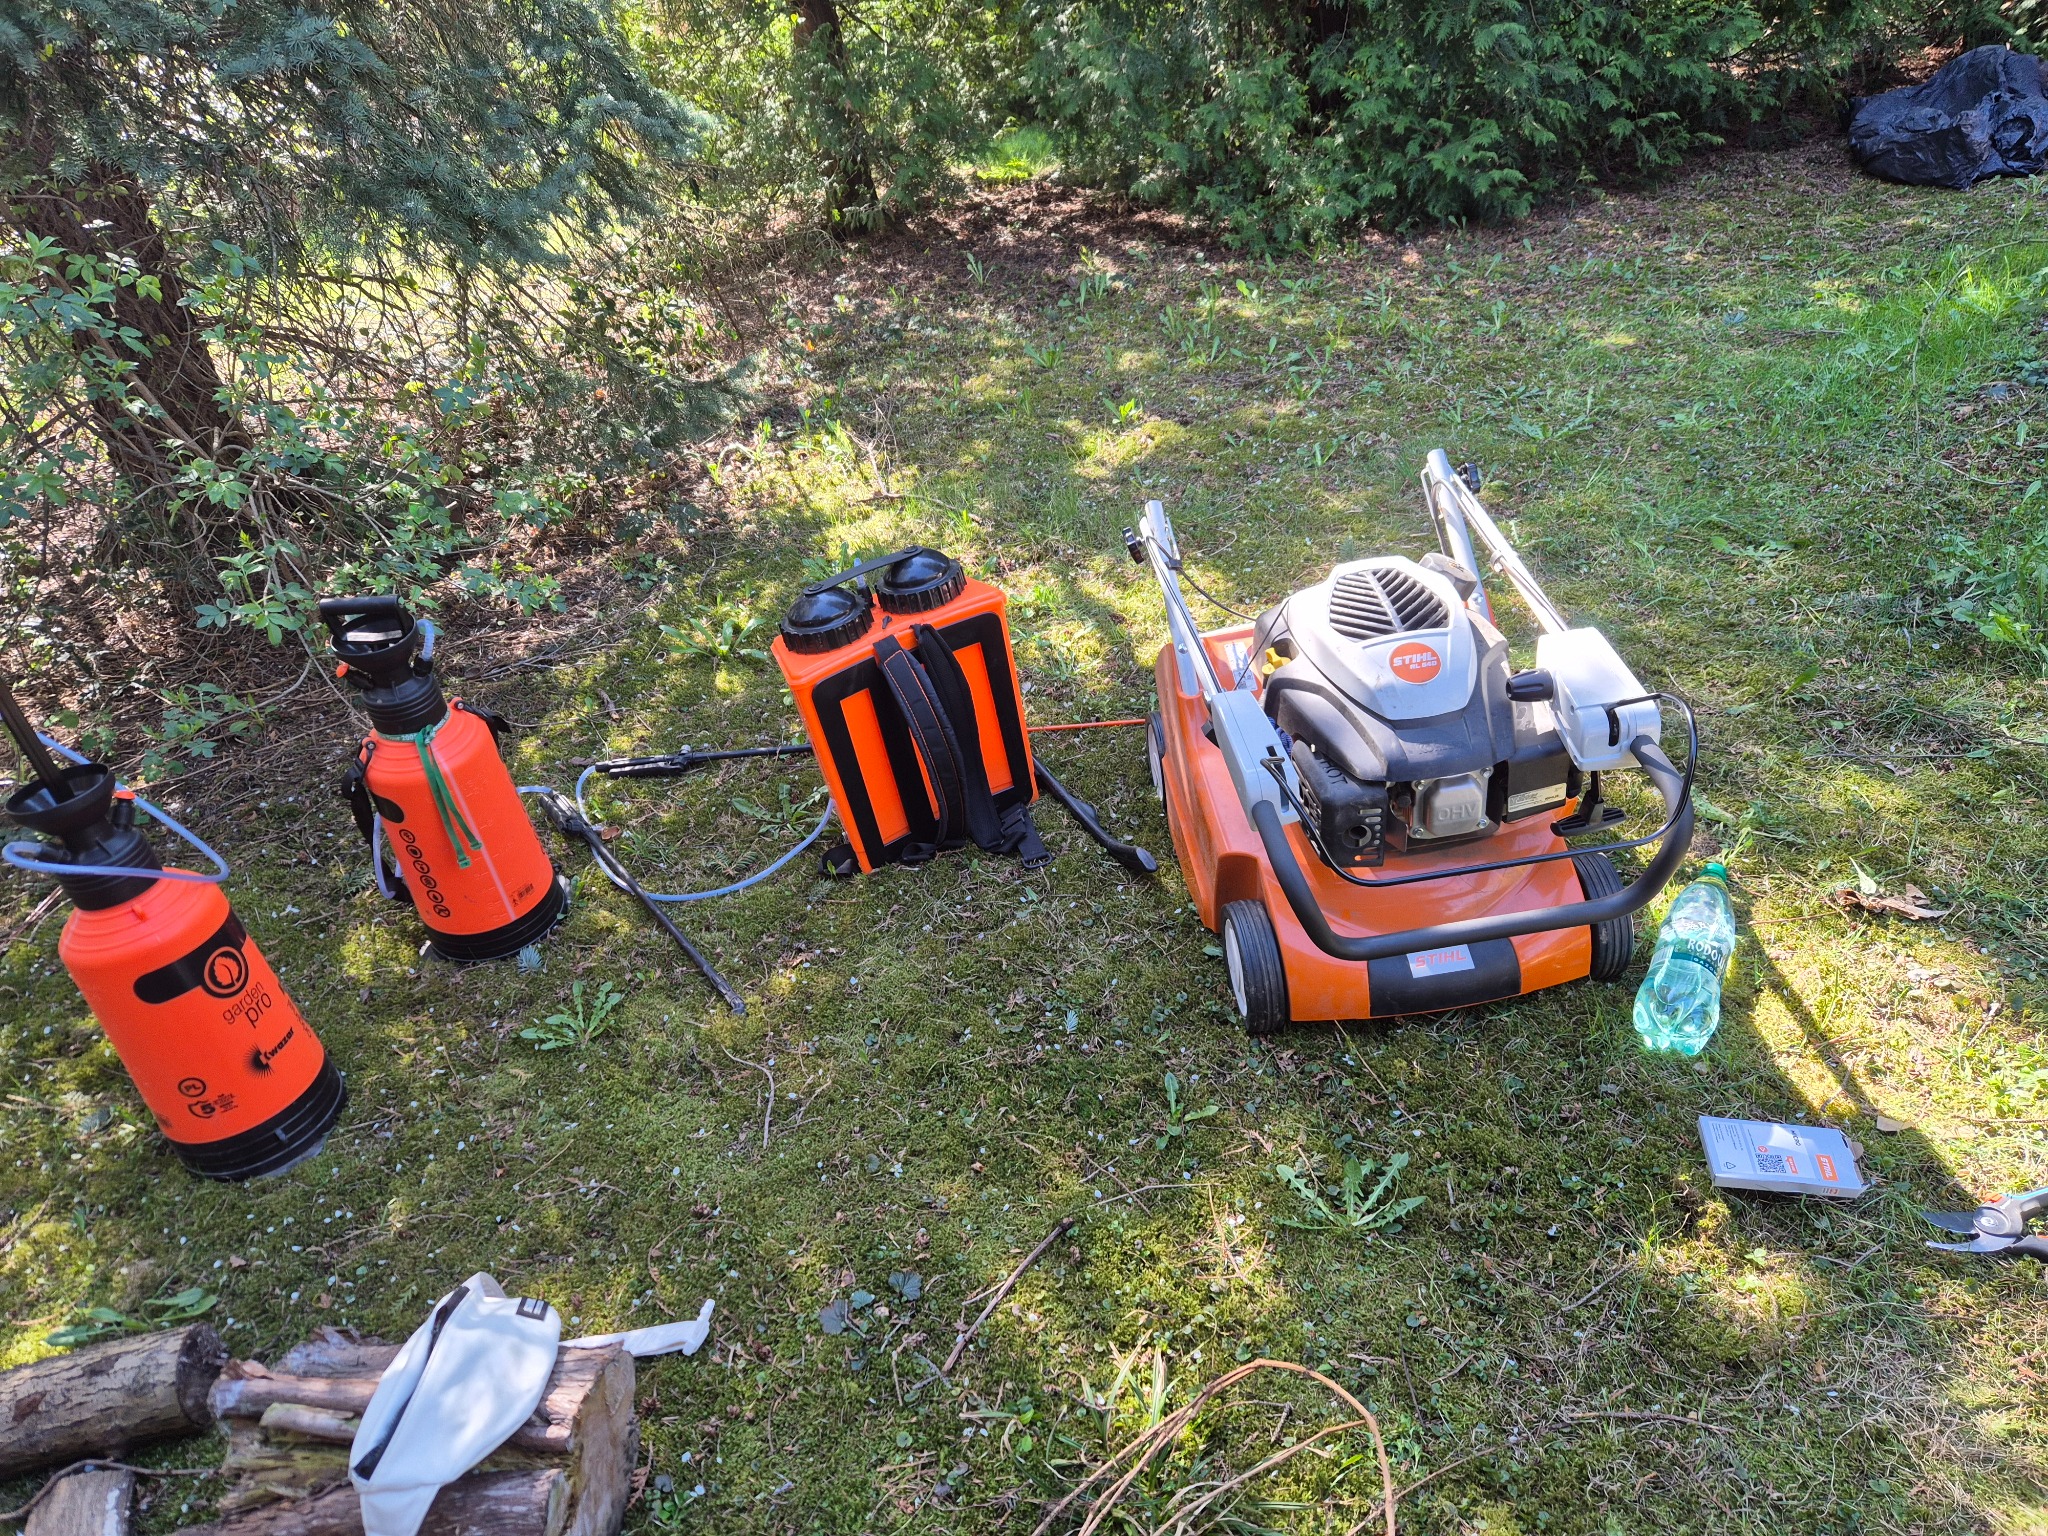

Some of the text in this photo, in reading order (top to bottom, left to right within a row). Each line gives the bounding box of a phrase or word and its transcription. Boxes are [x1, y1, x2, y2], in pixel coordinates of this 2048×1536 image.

[1393, 651, 1437, 667] STIHL
[1437, 803, 1477, 821] OHV
[1414, 950, 1468, 968] STIHL
[222, 981, 264, 1025] garden
[245, 993, 271, 1029] pro
[1820, 1156, 1833, 1178] STIHL
